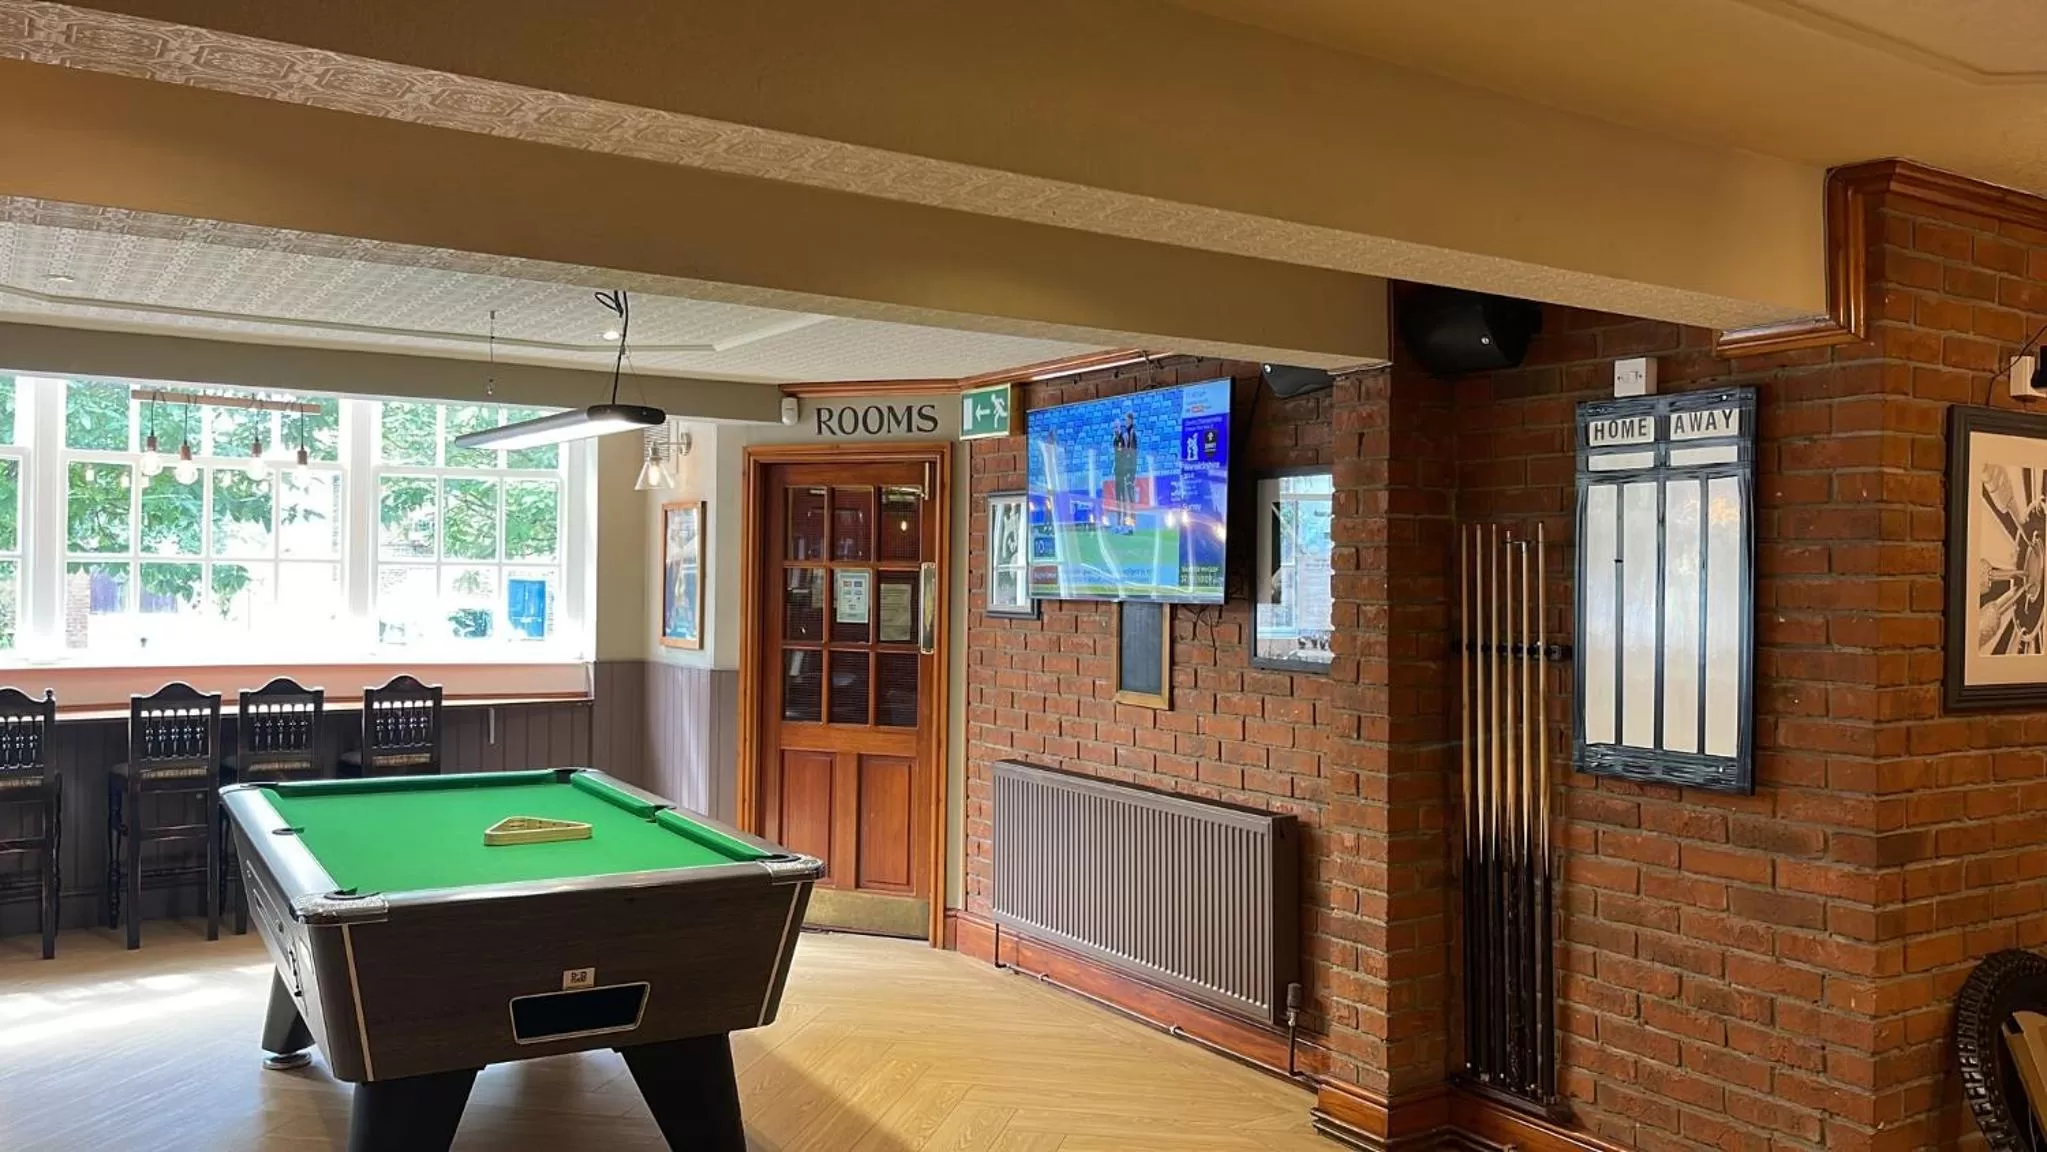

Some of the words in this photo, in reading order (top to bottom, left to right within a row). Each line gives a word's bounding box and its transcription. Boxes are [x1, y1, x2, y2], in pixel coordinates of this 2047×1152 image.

[815, 404, 939, 436] ROOMS
[1594, 418, 1648, 441] HOME
[1673, 409, 1733, 435] AWAY
